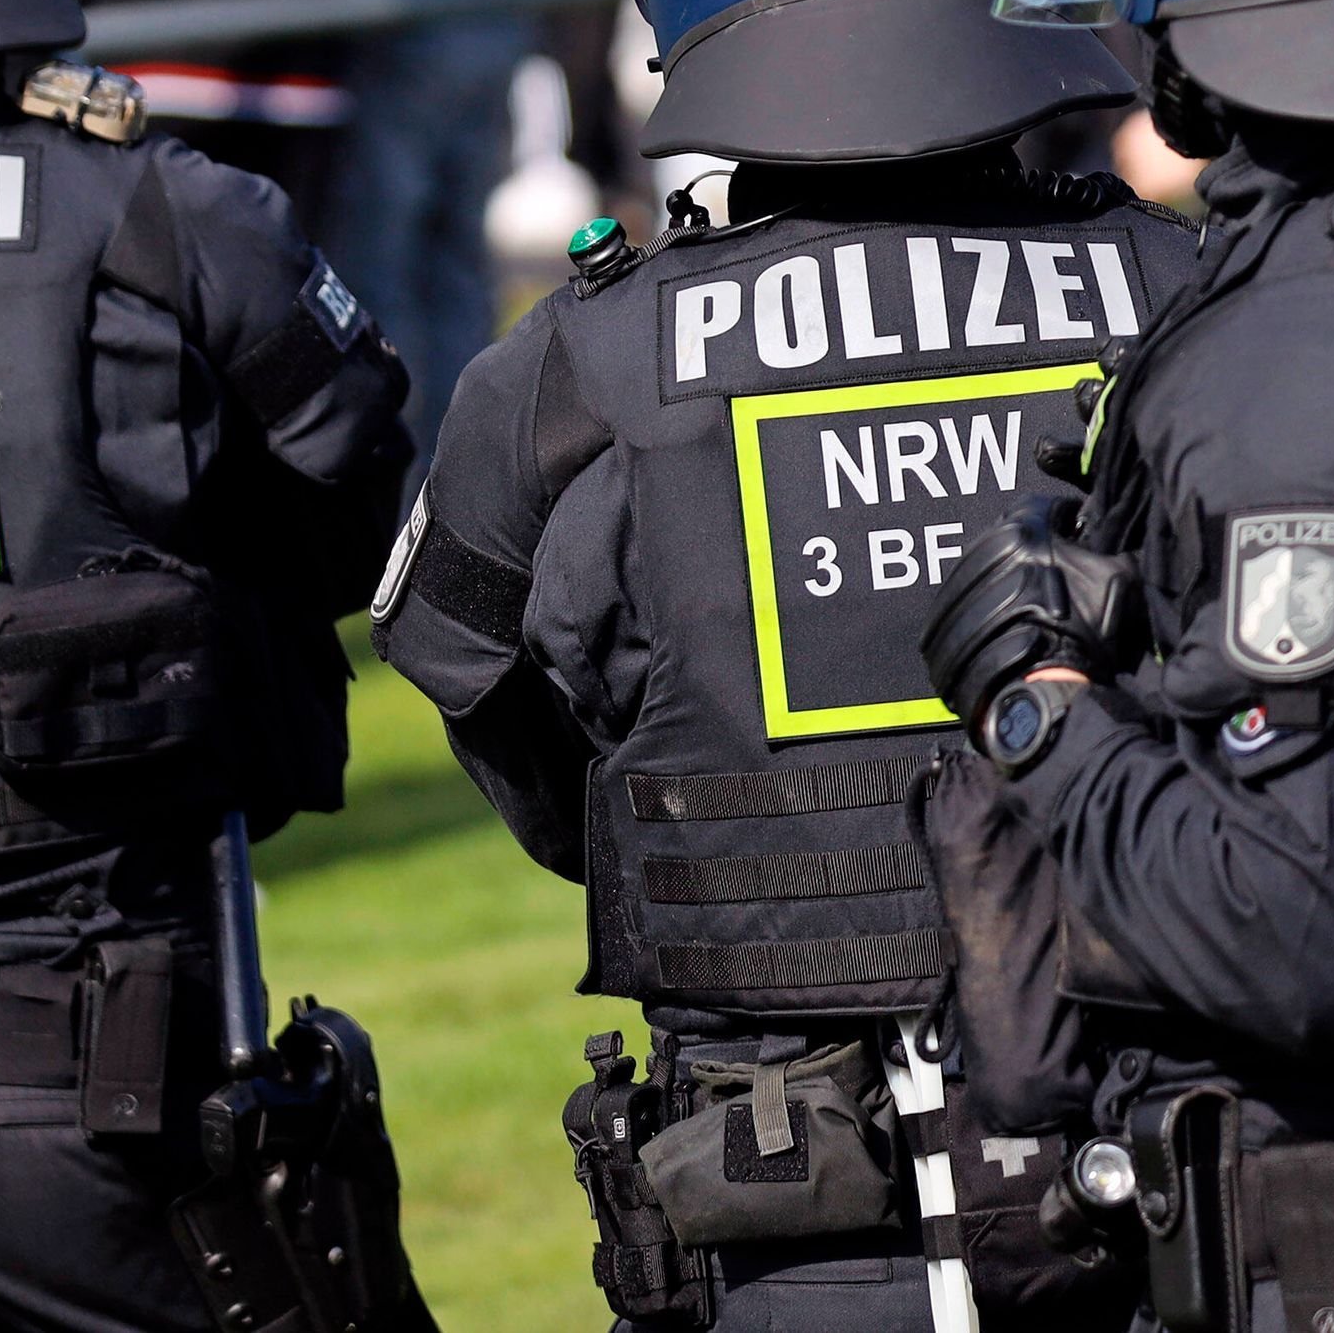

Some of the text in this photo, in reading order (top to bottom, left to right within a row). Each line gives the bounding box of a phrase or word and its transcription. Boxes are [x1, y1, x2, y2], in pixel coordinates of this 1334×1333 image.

[676, 237, 1139, 382] POLIZEI
[820, 410, 1022, 509] NRW
[802, 522, 965, 597] 3 BF
